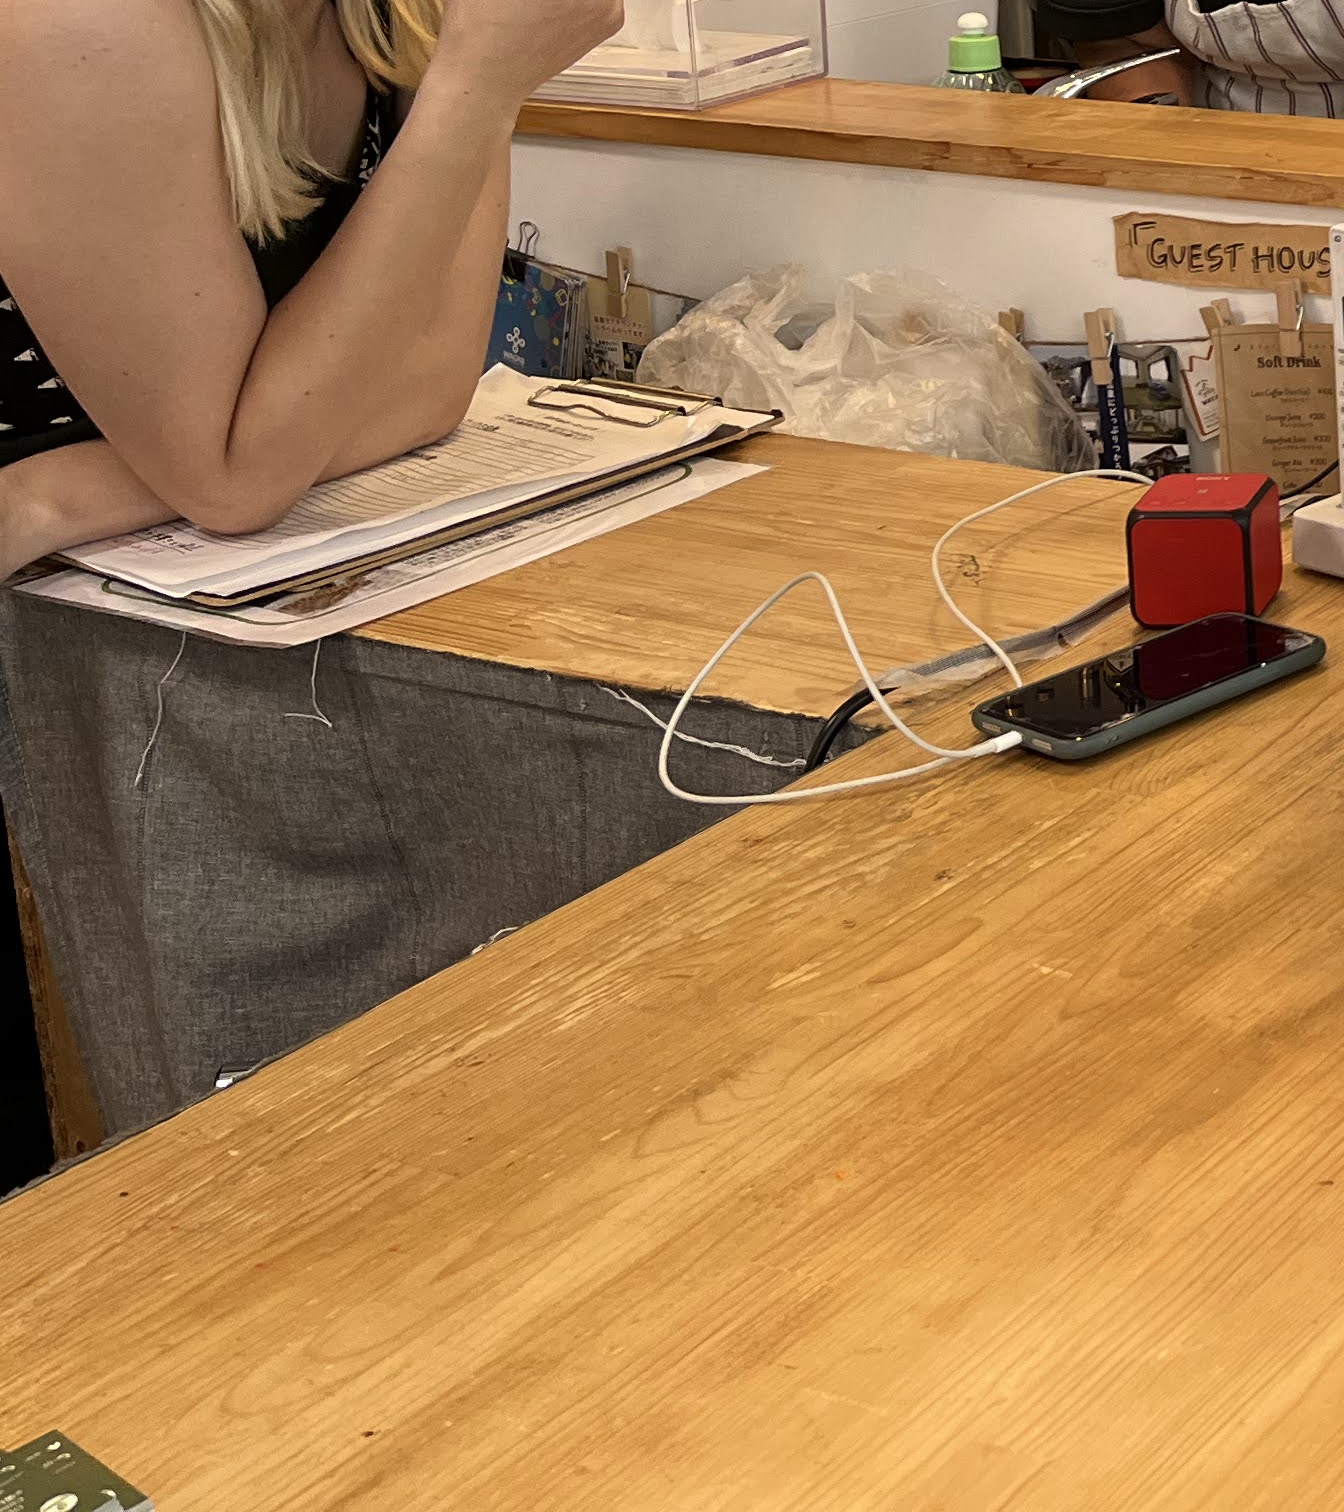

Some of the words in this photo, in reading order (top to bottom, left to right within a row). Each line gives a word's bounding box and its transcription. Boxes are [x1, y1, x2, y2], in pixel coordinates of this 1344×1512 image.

[1150, 238, 1245, 273] GUEST
[1257, 355, 1282, 369] Soft
[1287, 354, 1322, 368] Drink
